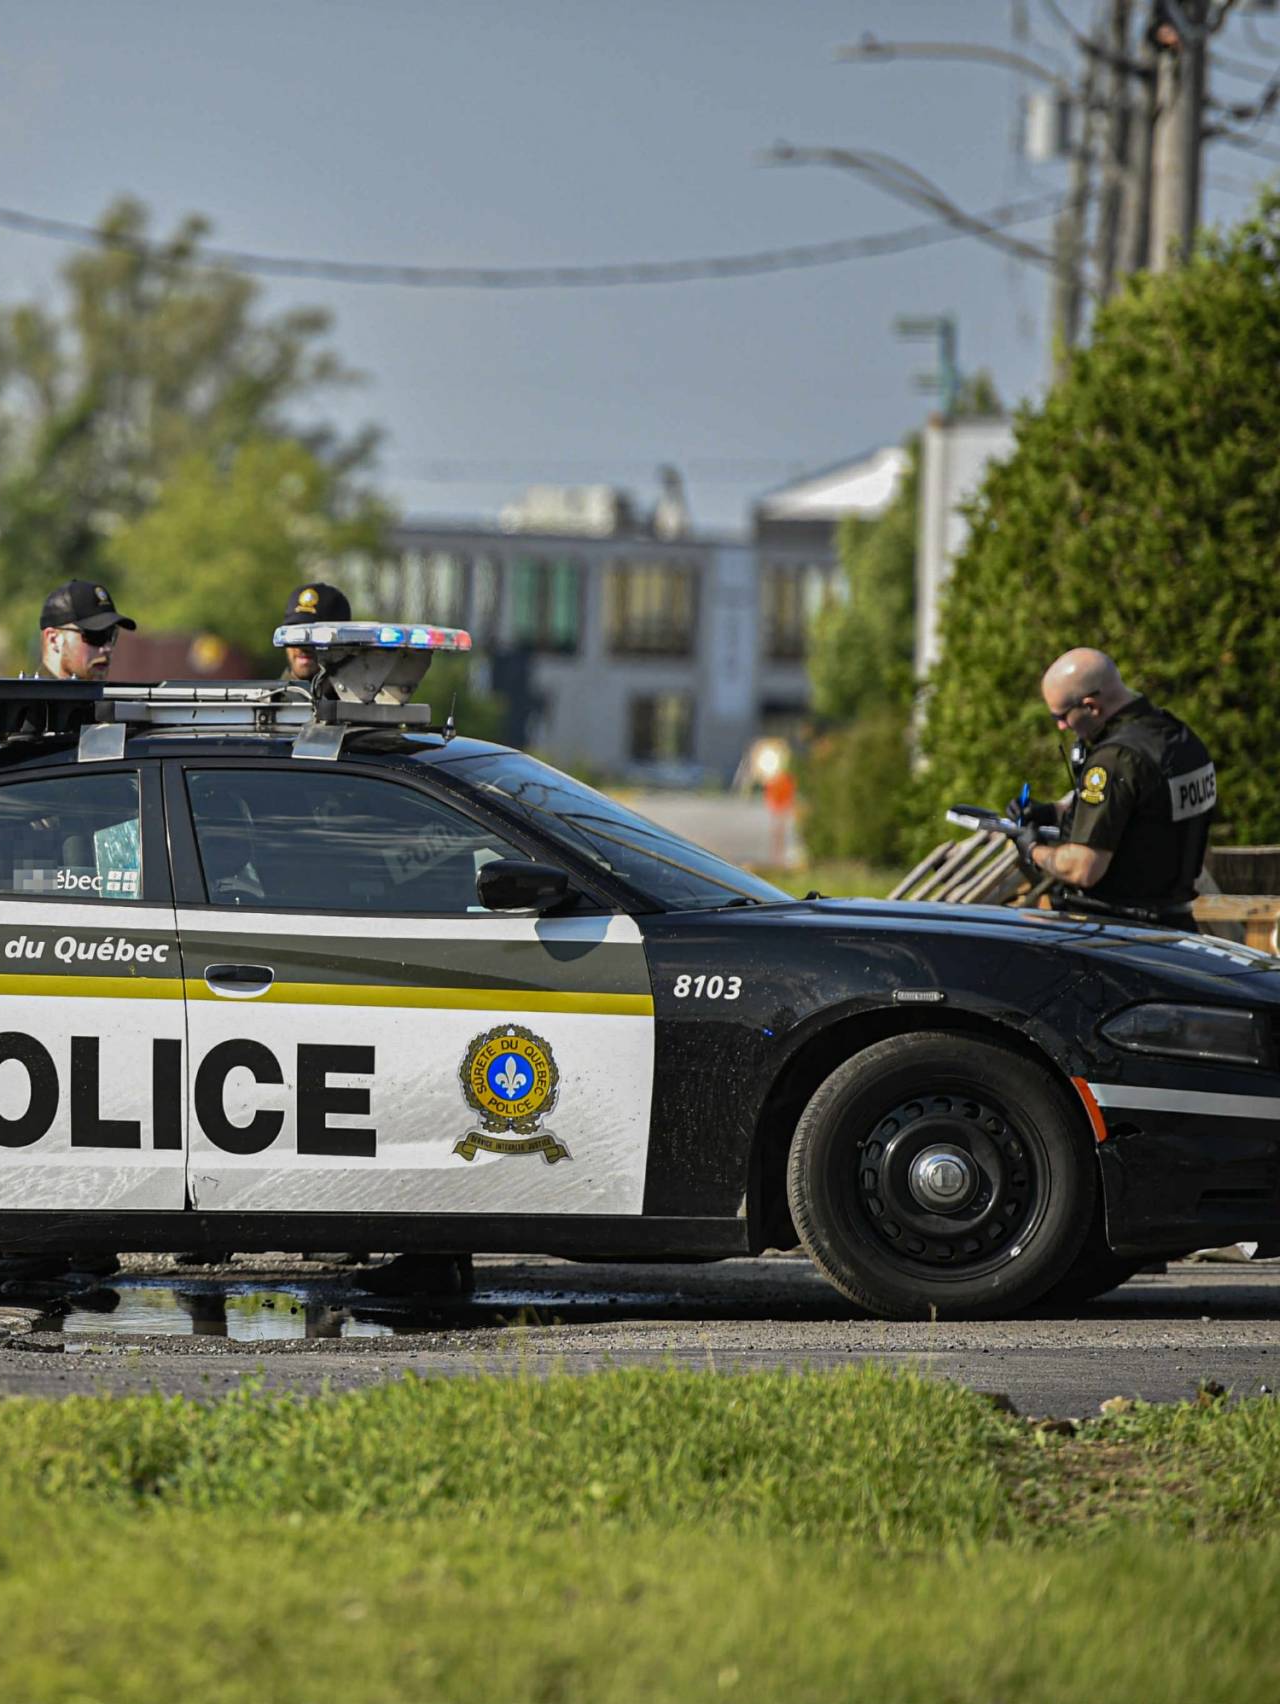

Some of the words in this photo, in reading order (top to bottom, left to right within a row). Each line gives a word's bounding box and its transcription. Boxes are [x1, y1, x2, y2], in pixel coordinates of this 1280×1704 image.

[1179, 773, 1215, 809] POLICE
[5, 935, 45, 959] du
[54, 936, 170, 963] Québec
[673, 974, 742, 1000] 8103
[500, 1039, 519, 1050] DU
[487, 1097, 534, 1115] POLICE
